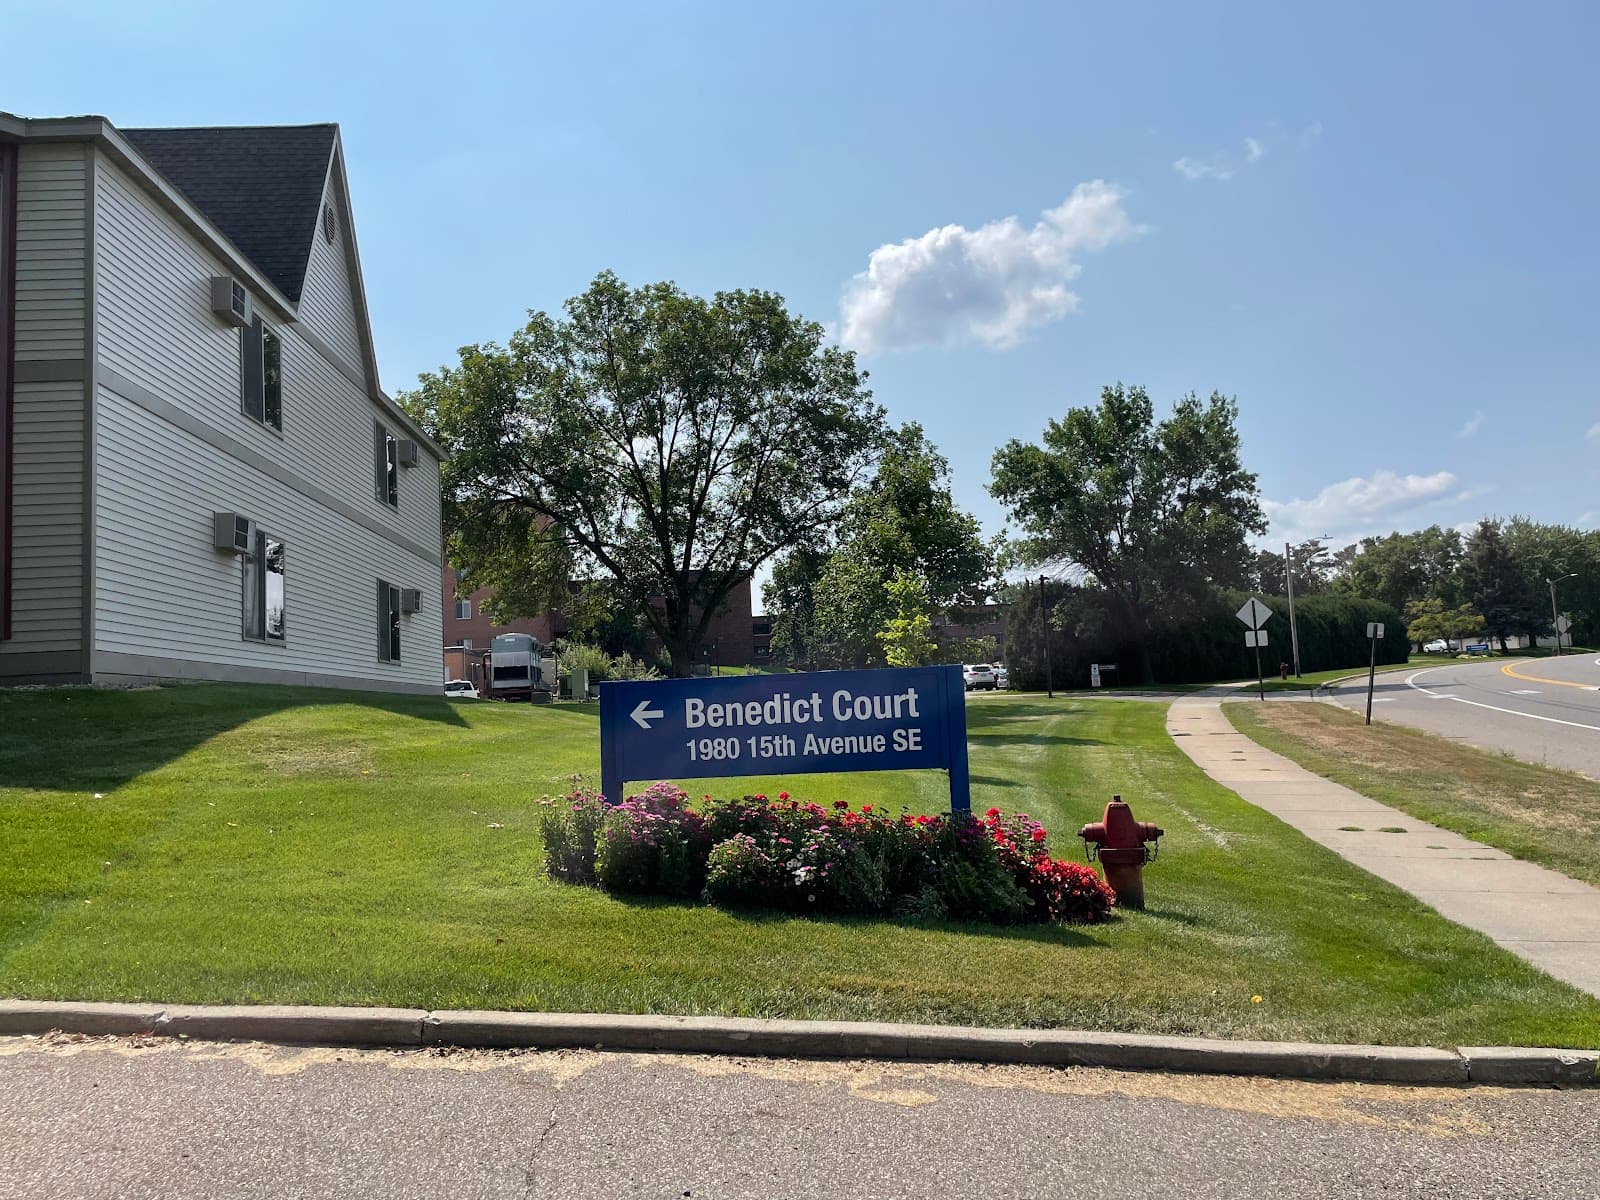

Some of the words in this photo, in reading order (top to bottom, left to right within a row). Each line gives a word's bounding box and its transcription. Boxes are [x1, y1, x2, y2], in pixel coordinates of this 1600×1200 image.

[685, 692, 824, 729] Benedict
[832, 687, 920, 722] Court
[686, 737, 740, 761] 1980
[746, 734, 796, 758] 15th
[803, 732, 886, 756] Avenue
[892, 728, 922, 752] SE
